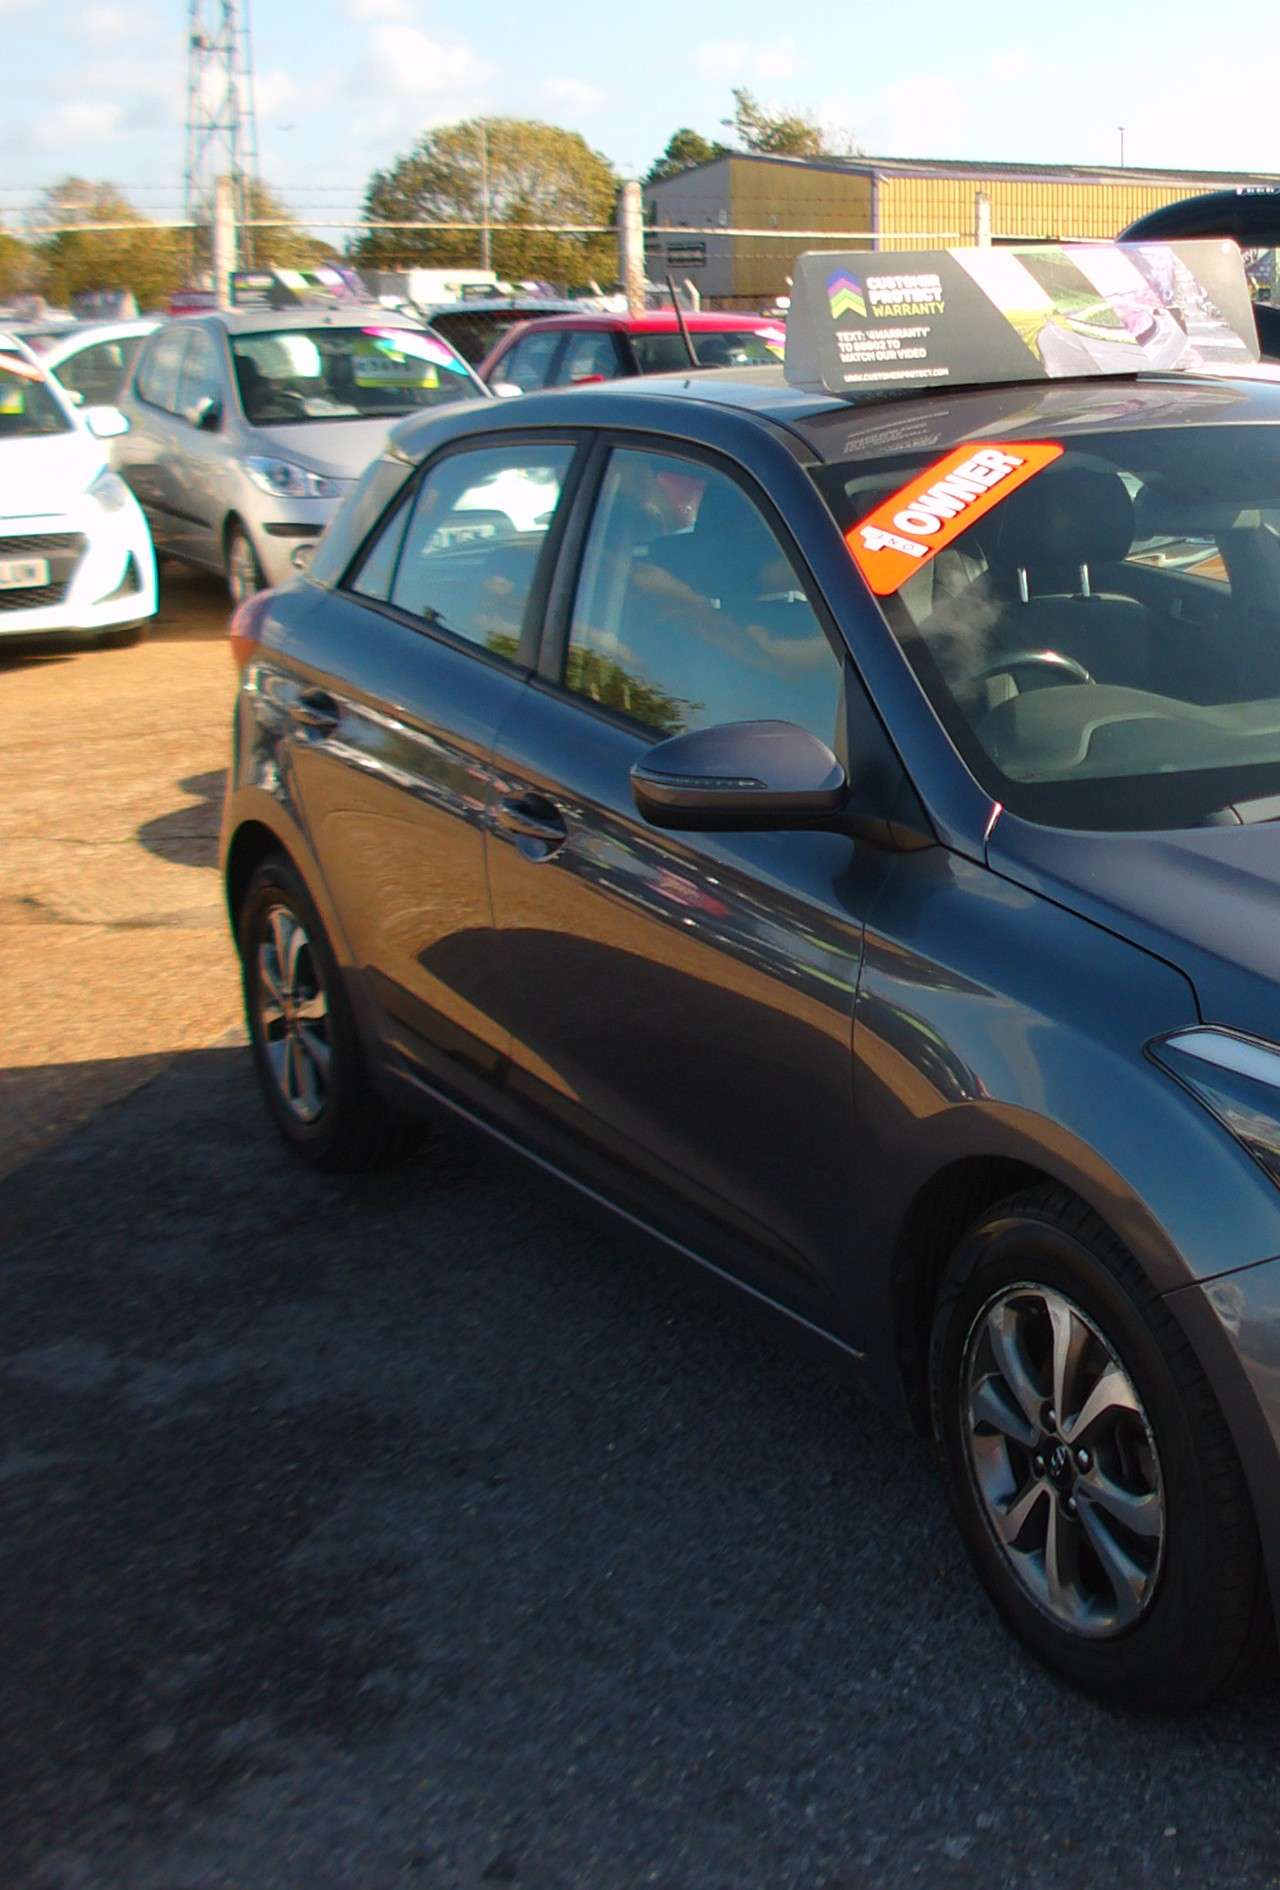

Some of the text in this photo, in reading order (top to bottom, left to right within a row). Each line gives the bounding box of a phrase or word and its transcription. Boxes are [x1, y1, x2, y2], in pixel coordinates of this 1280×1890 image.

[867, 274, 941, 290] CUSTOMER
[868, 288, 942, 304] PROTECT
[872, 302, 945, 318] WARRANTY
[838, 342, 853, 352] TO
[886, 340, 901, 349] TO
[840, 348, 927, 363] WATCH OUR VIDEO
[893, 449, 1027, 536] OWNER
